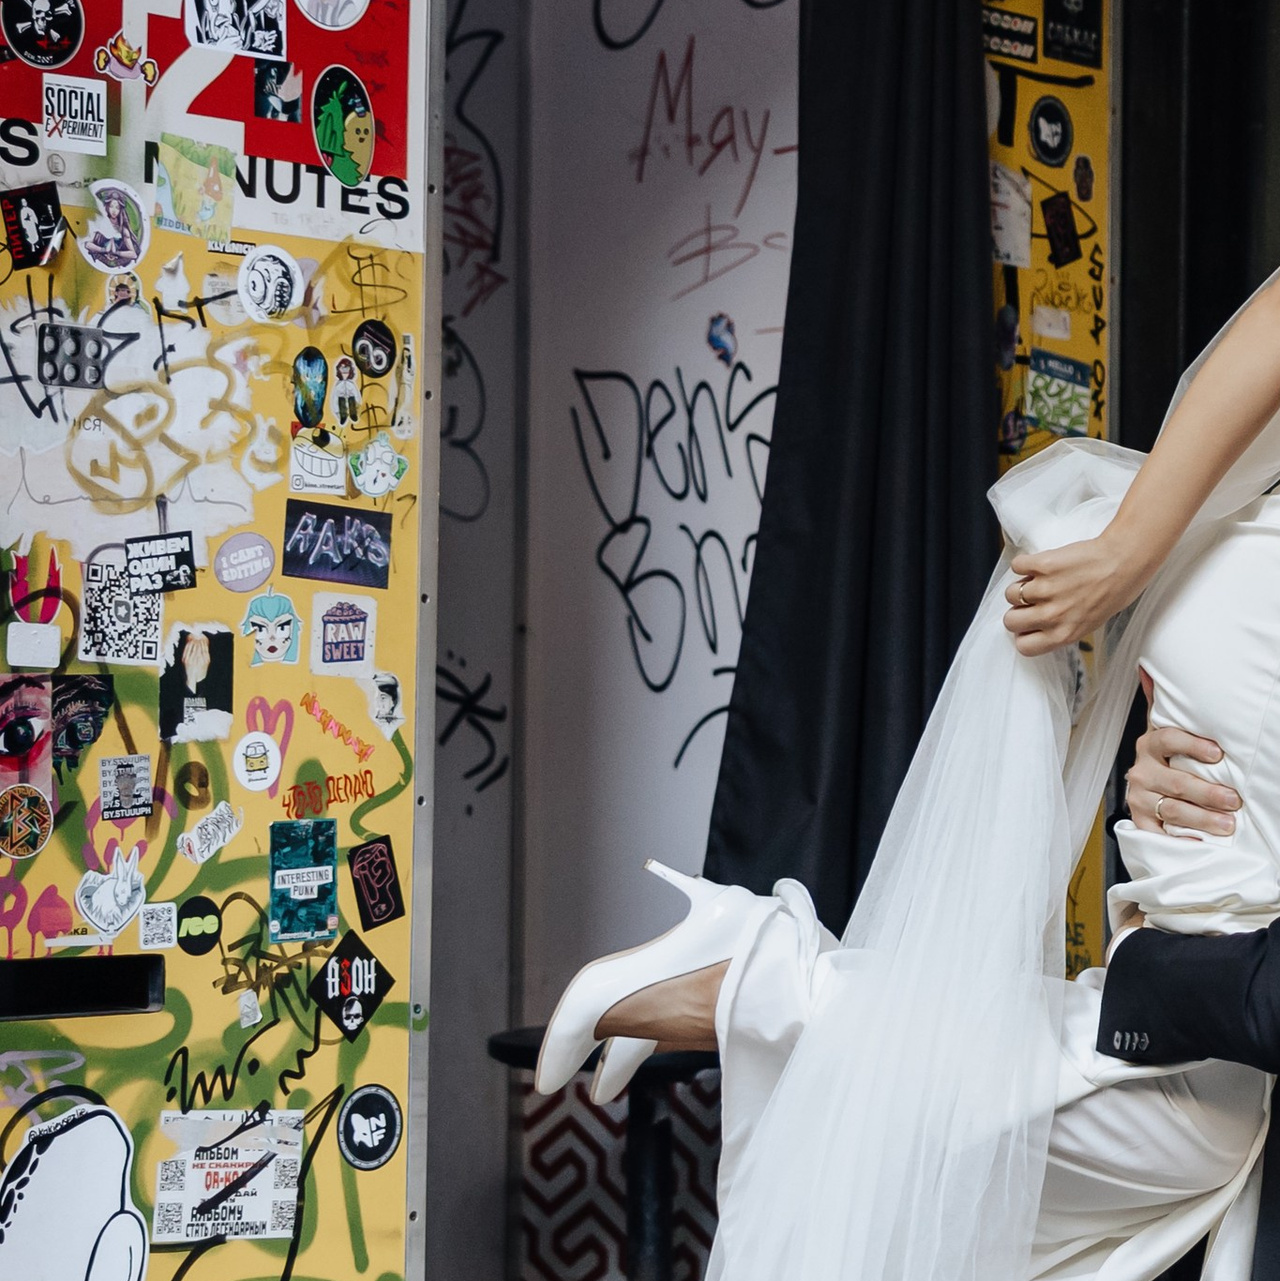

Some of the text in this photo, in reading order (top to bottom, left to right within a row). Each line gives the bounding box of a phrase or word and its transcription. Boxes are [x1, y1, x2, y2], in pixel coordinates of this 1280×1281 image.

[45, 86, 105, 123] SOCIAL
[45, 115, 104, 139] EXPERIMENT
[2, 199, 25, 260] ПИТЕР
[126, 536, 190, 559] ЖИВЕМ
[127, 555, 177, 576] ОДИН
[130, 574, 164, 592] РАЗ
[324, 621, 365, 643] RAW
[324, 642, 365, 661] SWEET
[276, 869, 330, 886] INTERESTING
[292, 885, 316, 896] PUNK
[194, 1147, 239, 1161] АЛЬБОМ
[185, 1220, 267, 1238] СТАТЬ ЛЕГЕНДАРНЫМ
